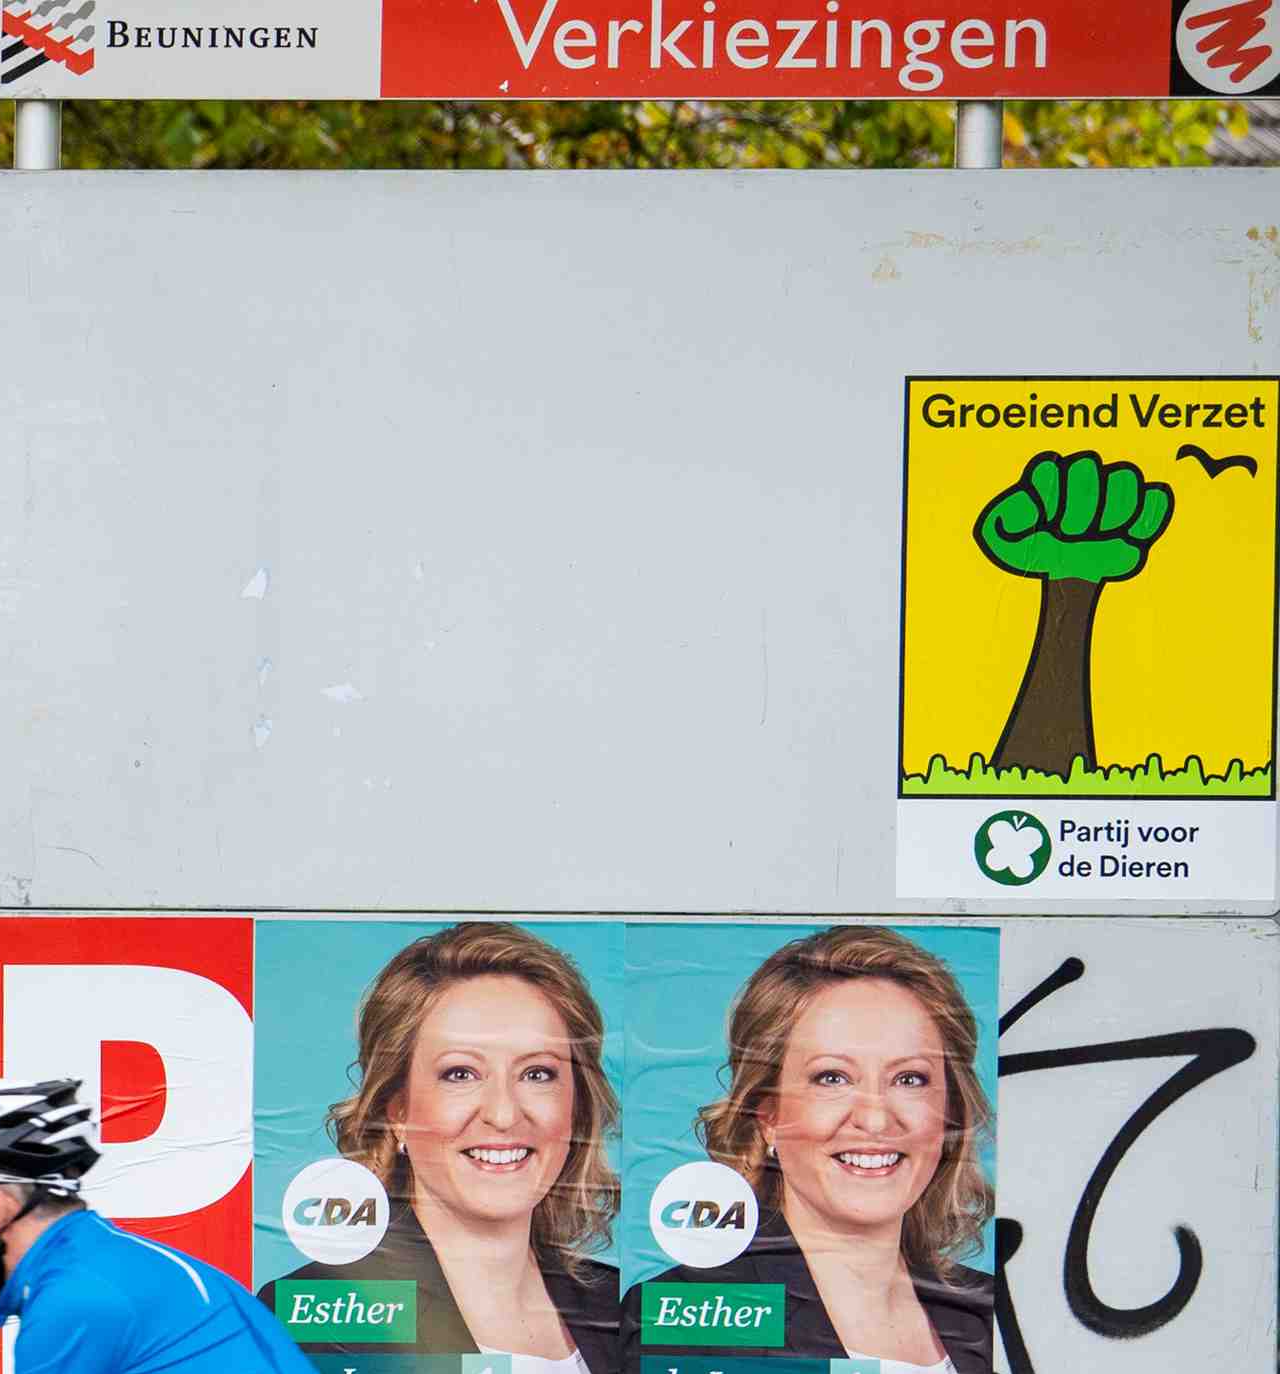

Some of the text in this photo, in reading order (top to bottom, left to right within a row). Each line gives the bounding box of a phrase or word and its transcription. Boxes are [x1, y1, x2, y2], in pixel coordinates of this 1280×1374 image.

[499, 0, 1047, 92] Verkiezingen
[921, 393, 1265, 429] Groeiend Verzet
[1059, 819, 1200, 848] Partij voor
[1057, 854, 1190, 878] de Dieren
[291, 1196, 378, 1228] CDA
[659, 1199, 747, 1231] CDA
[287, 1293, 404, 1326] Esther
[654, 1296, 772, 1329] Esther
